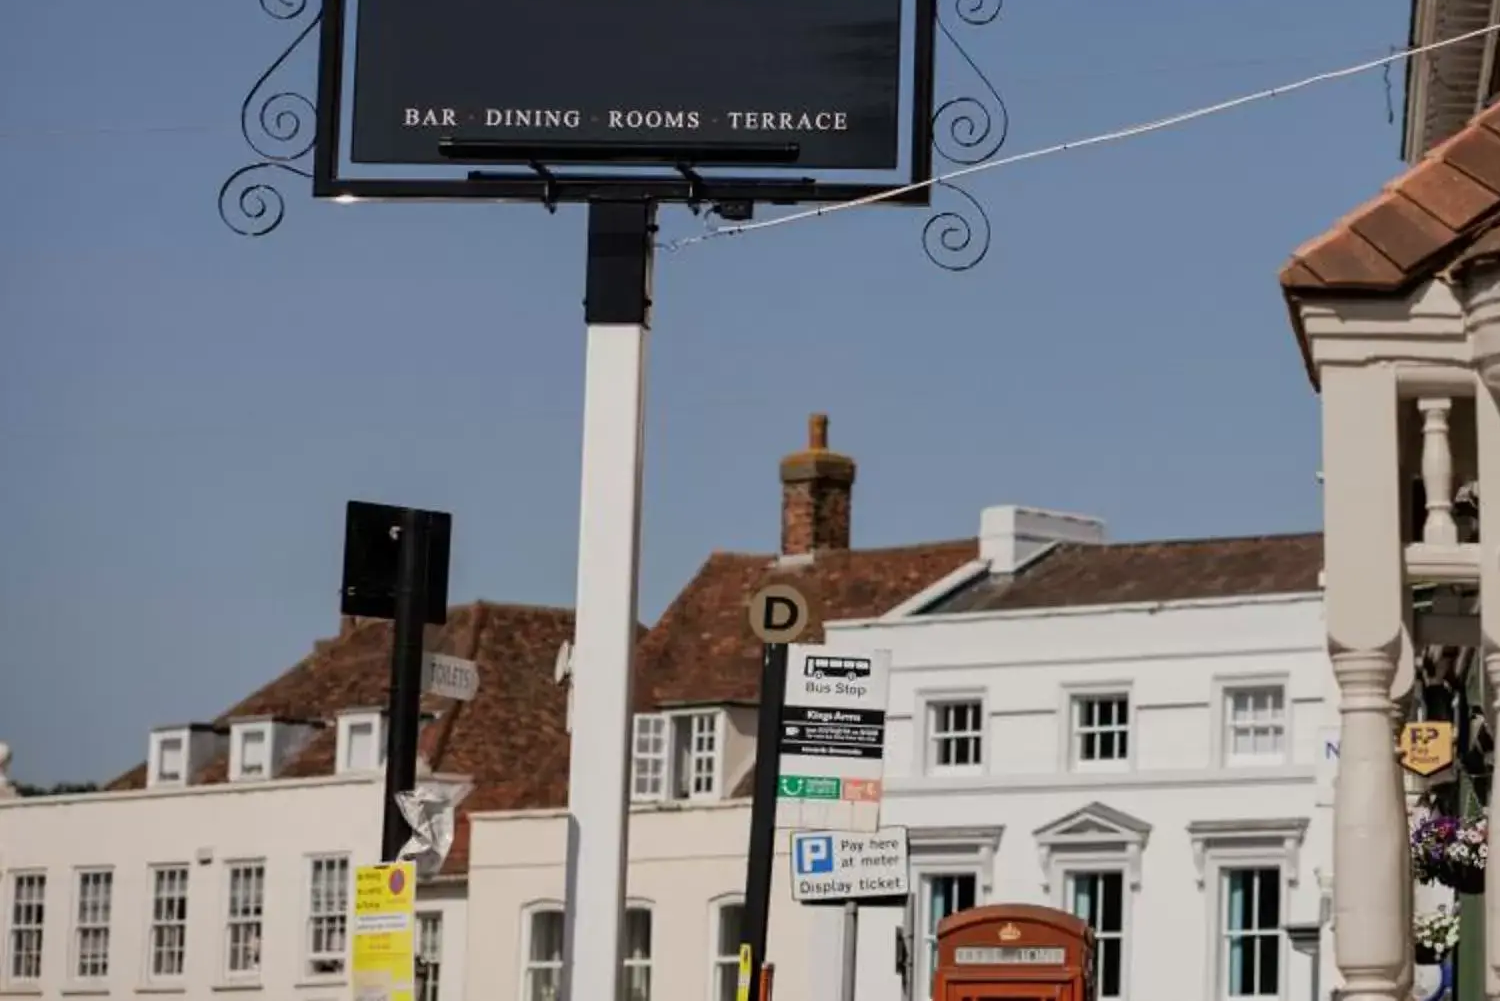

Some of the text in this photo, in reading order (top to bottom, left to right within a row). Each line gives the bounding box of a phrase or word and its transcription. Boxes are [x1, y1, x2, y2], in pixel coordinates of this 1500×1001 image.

[404, 108, 847, 131] BAR DINING ROOMS TERRACE
[764, 596, 798, 630] D
[429, 662, 472, 689] TOILETS
[805, 681, 867, 698] Bus Stop
[803, 839, 827, 872] P
[841, 839, 899, 852] Pay here
[842, 855, 899, 868] at meter
[800, 877, 902, 895] Display ticket
